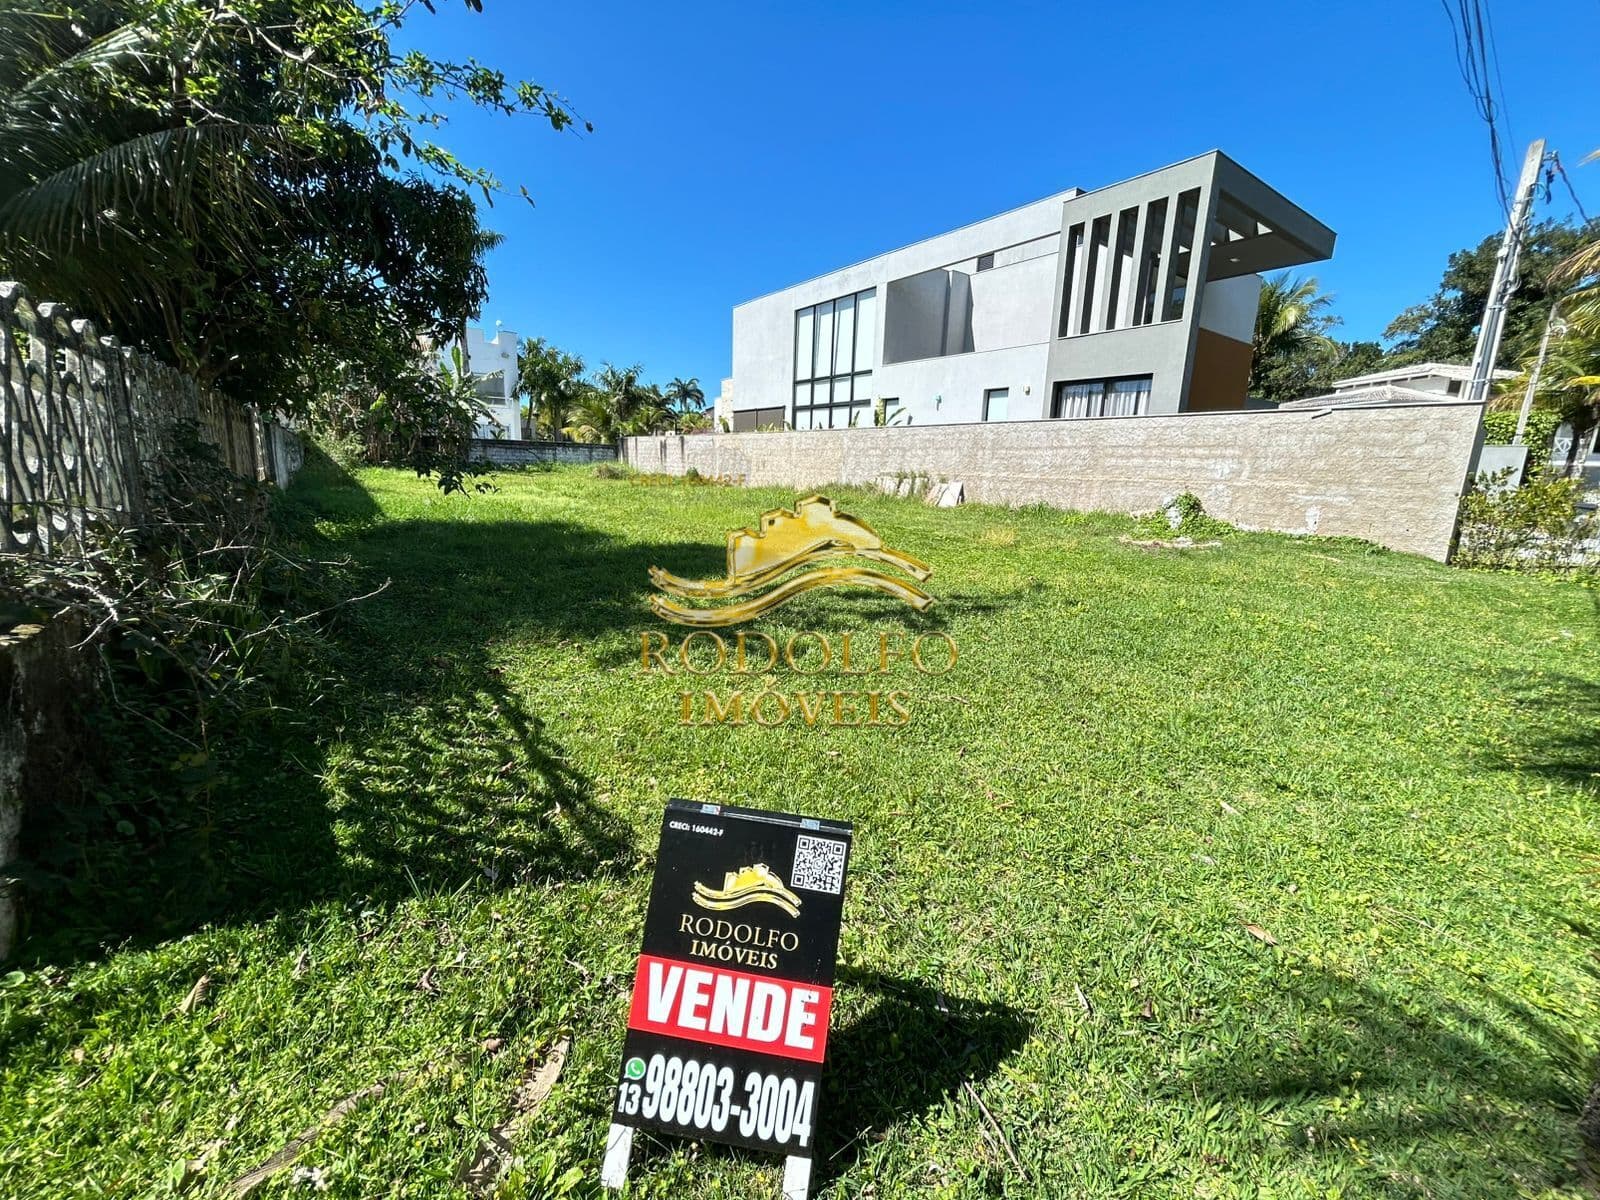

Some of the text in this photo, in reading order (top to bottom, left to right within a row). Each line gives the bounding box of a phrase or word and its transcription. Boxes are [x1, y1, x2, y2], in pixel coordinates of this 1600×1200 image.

[678, 914, 799, 951] RODOLFO
[690, 939, 778, 969] IMÓVEIS
[647, 962, 819, 1050] VENDE
[617, 1053, 815, 1147] 13 98803-3004
